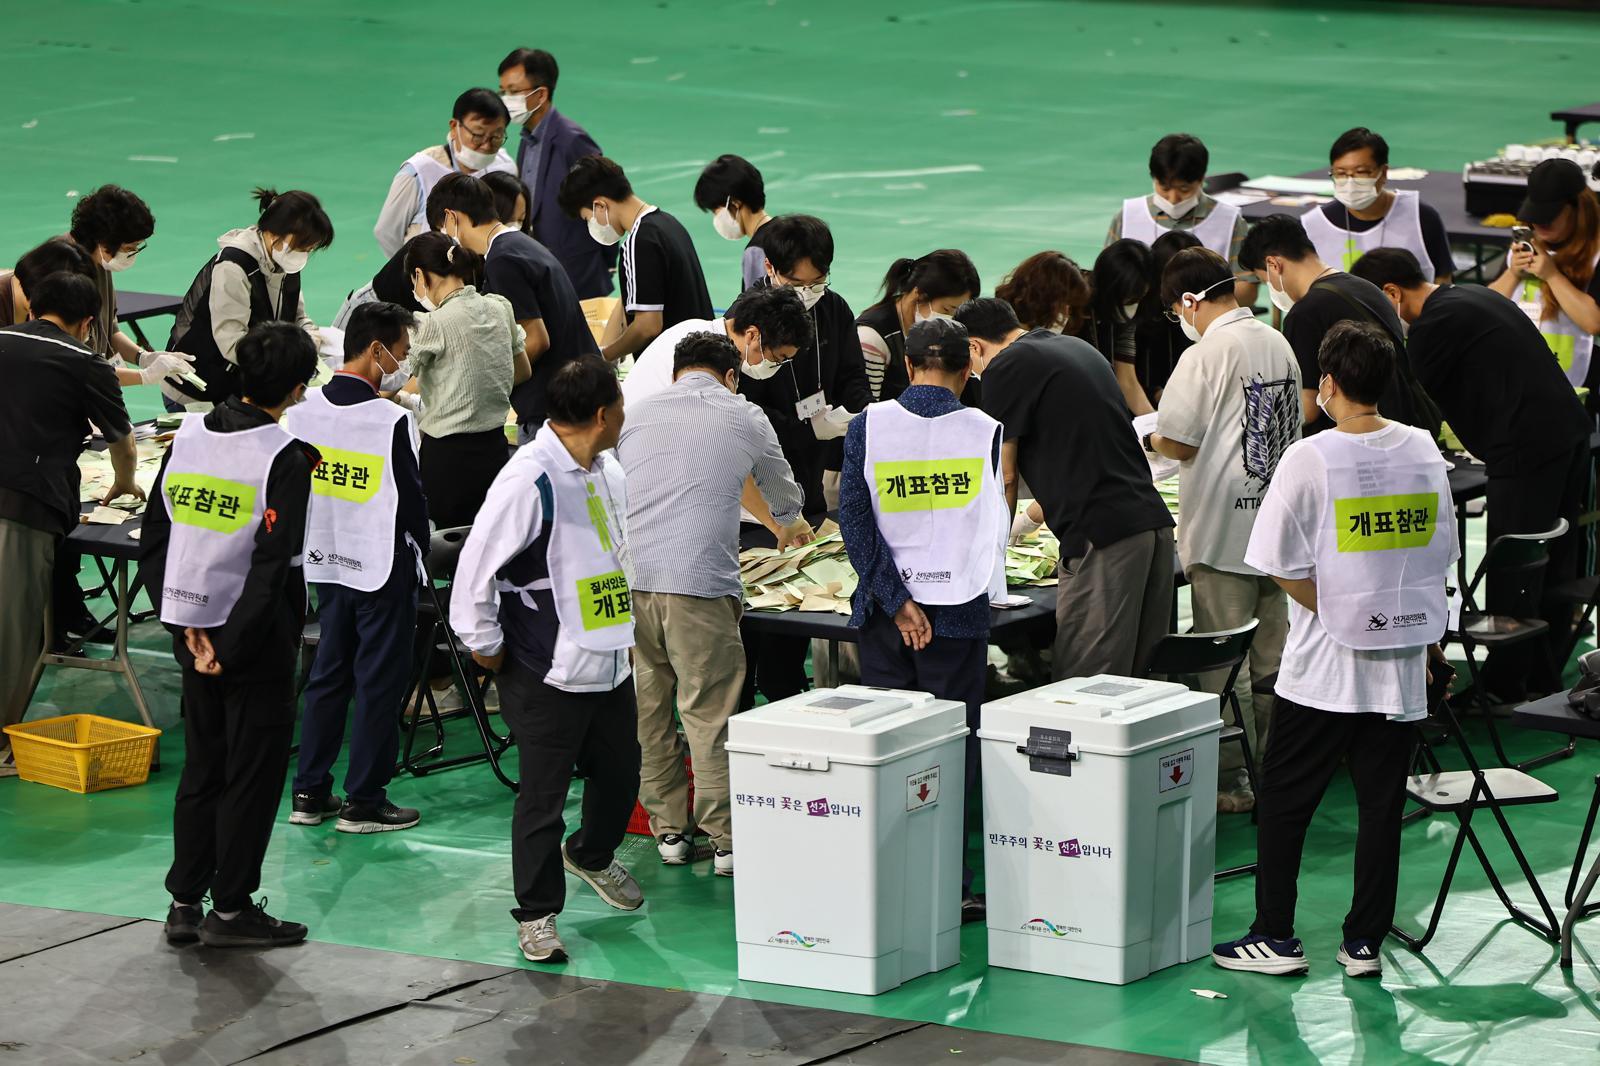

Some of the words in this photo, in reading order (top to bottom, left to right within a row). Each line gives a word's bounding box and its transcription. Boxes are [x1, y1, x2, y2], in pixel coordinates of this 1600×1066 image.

[314, 461, 369, 490] 표참관
[886, 471, 971, 498] 개표참관
[1349, 507, 1429, 537] 개표참관
[590, 576, 626, 595] 질서있는
[593, 591, 631, 618] 개표
[736, 794, 775, 808] 민주주의
[781, 796, 803, 811] 꽃은
[989, 833, 1027, 848] 민주주의
[1033, 836, 1054, 852] 꽃은
